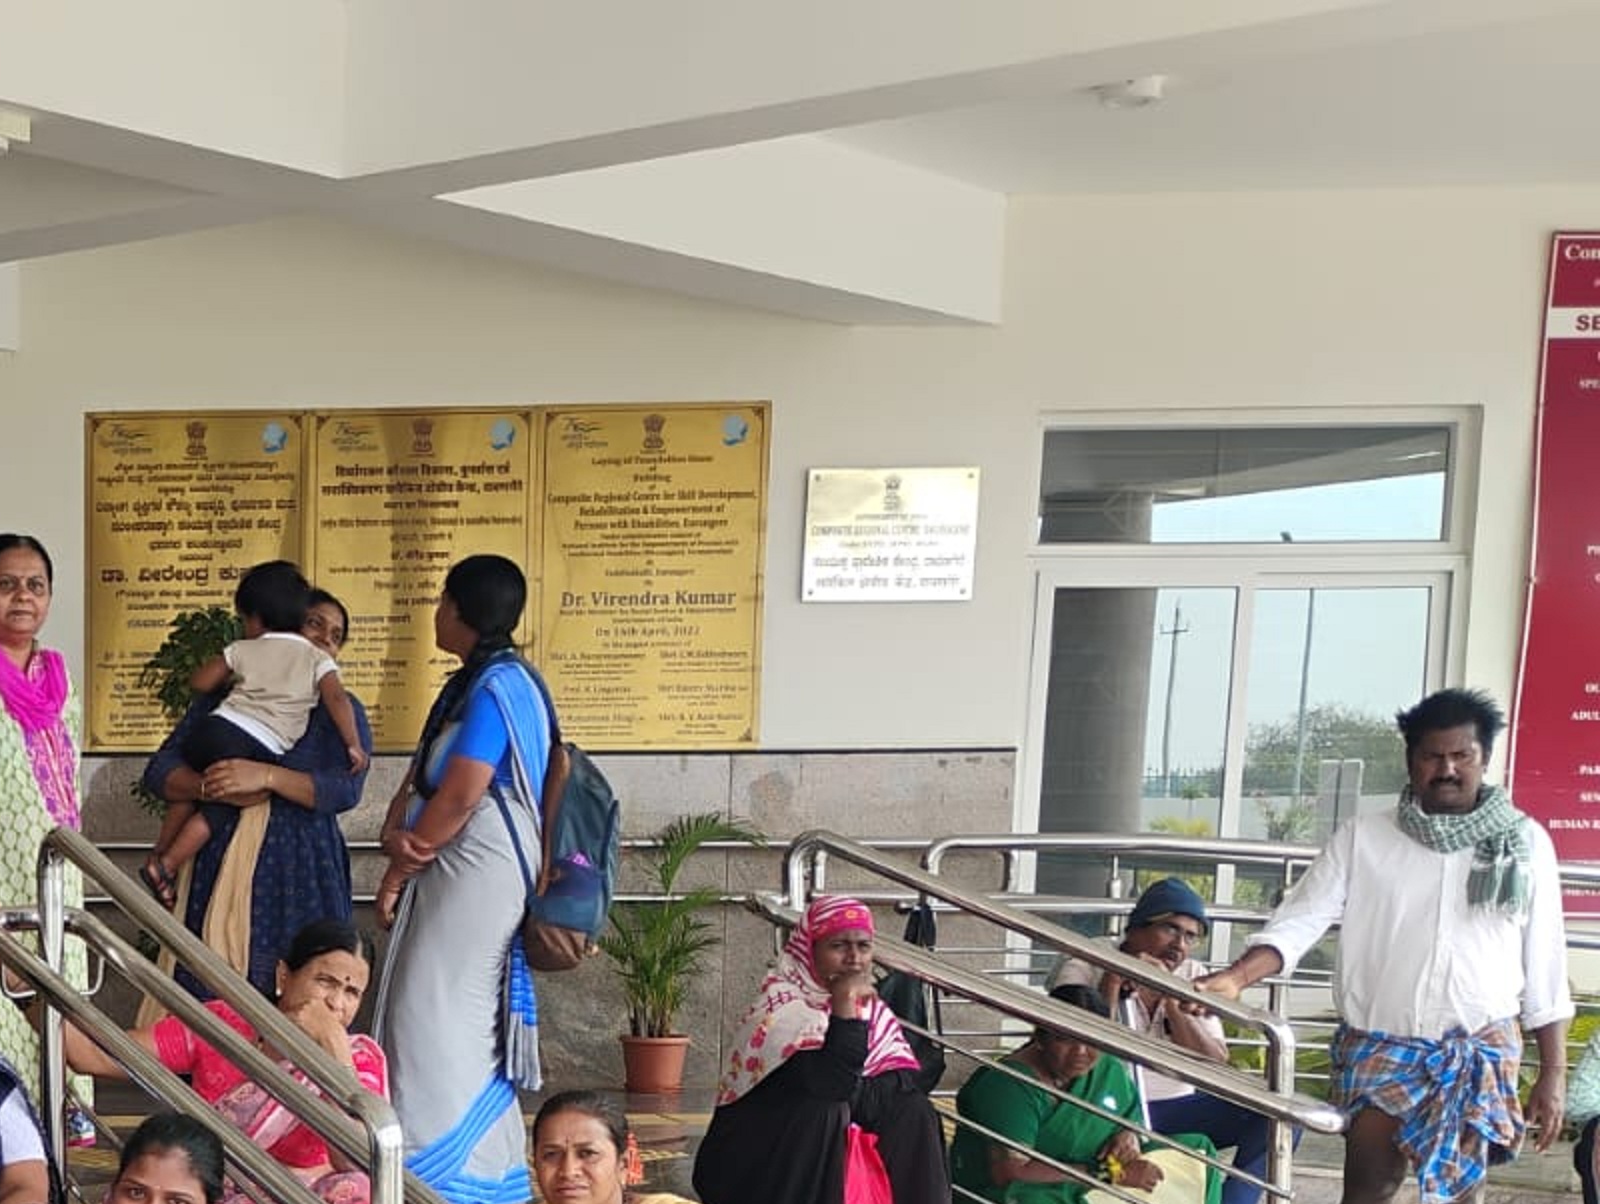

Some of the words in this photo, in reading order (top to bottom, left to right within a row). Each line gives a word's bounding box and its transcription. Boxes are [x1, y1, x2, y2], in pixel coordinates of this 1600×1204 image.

[561, 592, 584, 608] Dr.
[591, 591, 670, 607] Virendra
[675, 591, 737, 605] Kumar
